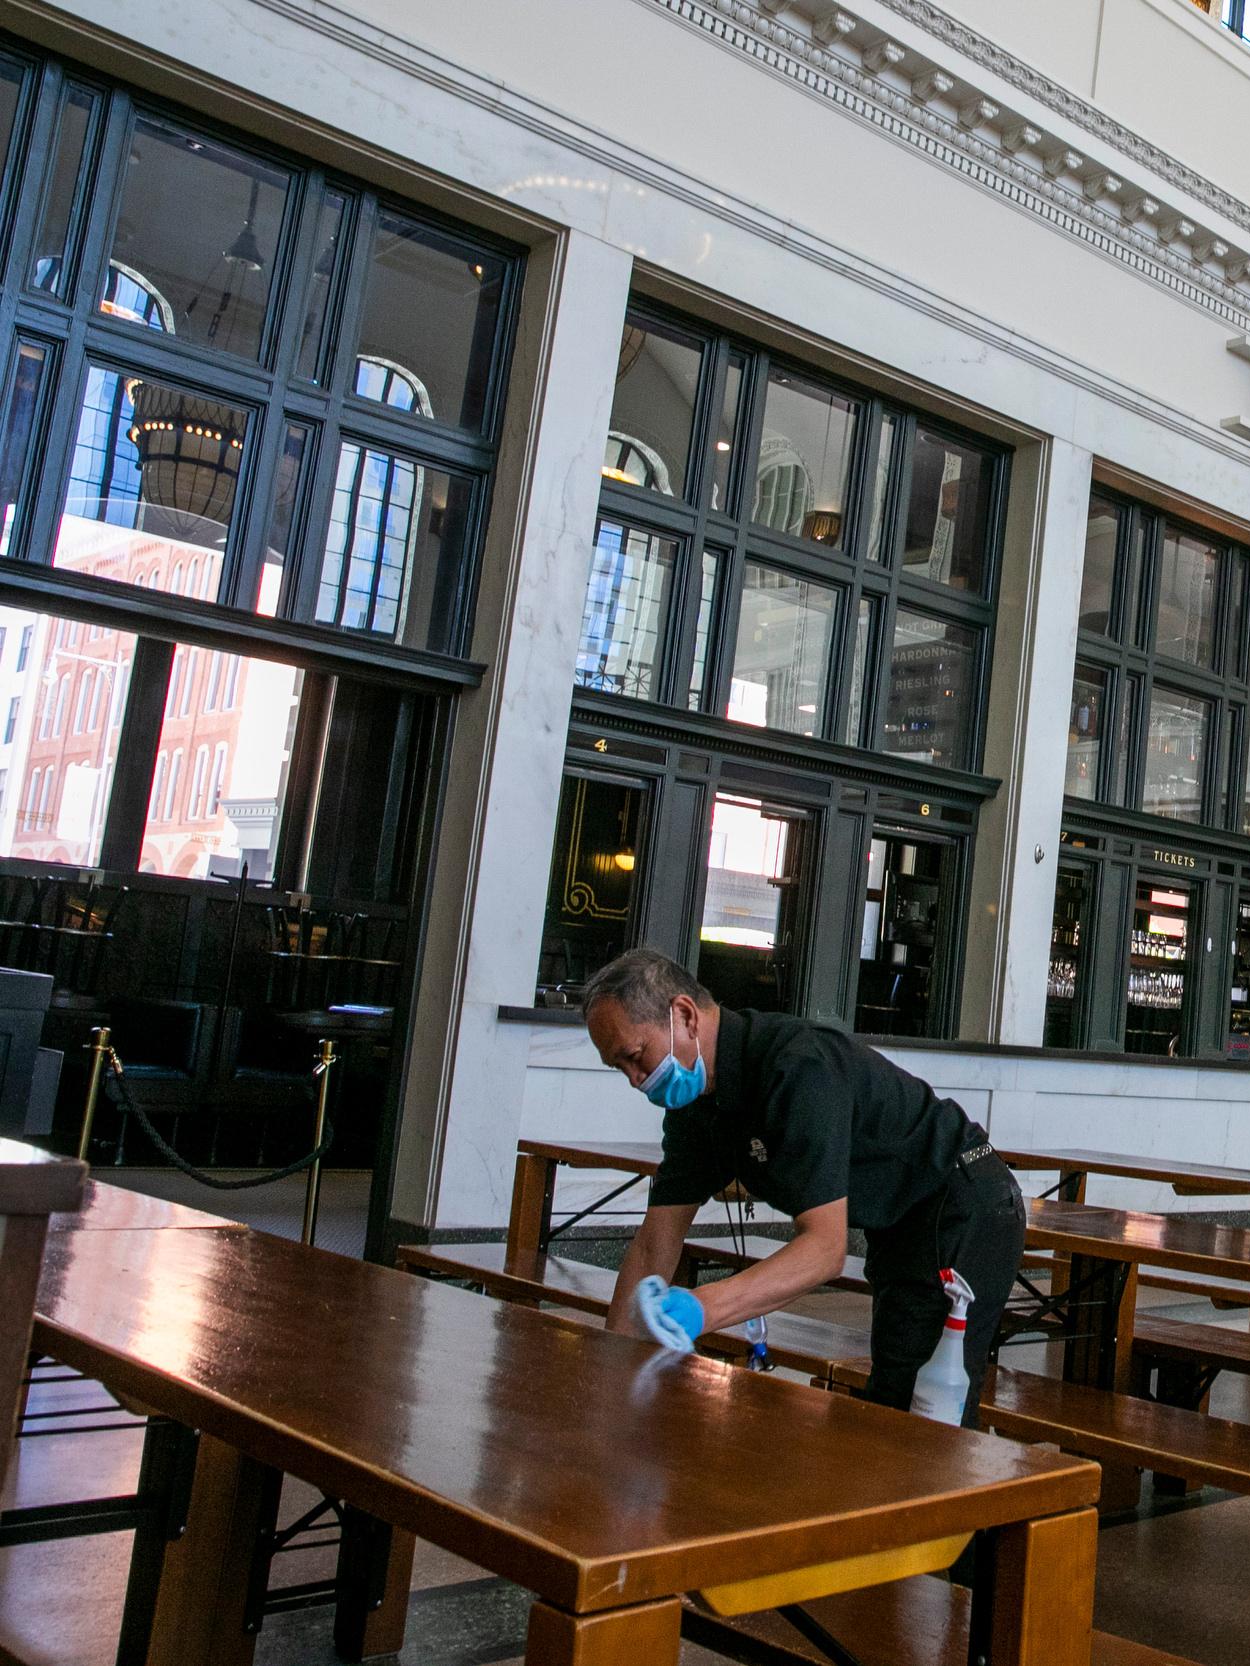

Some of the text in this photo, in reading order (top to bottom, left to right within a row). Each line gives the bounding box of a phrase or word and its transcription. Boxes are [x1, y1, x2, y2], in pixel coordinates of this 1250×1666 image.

[895, 674, 951, 690] RIESLING
[594, 738, 608, 752] 4
[898, 732, 945, 746] MERLOT
[921, 803, 930, 816] 6
[1060, 831, 1068, 842] 7
[1153, 850, 1196, 868] TICKETS
